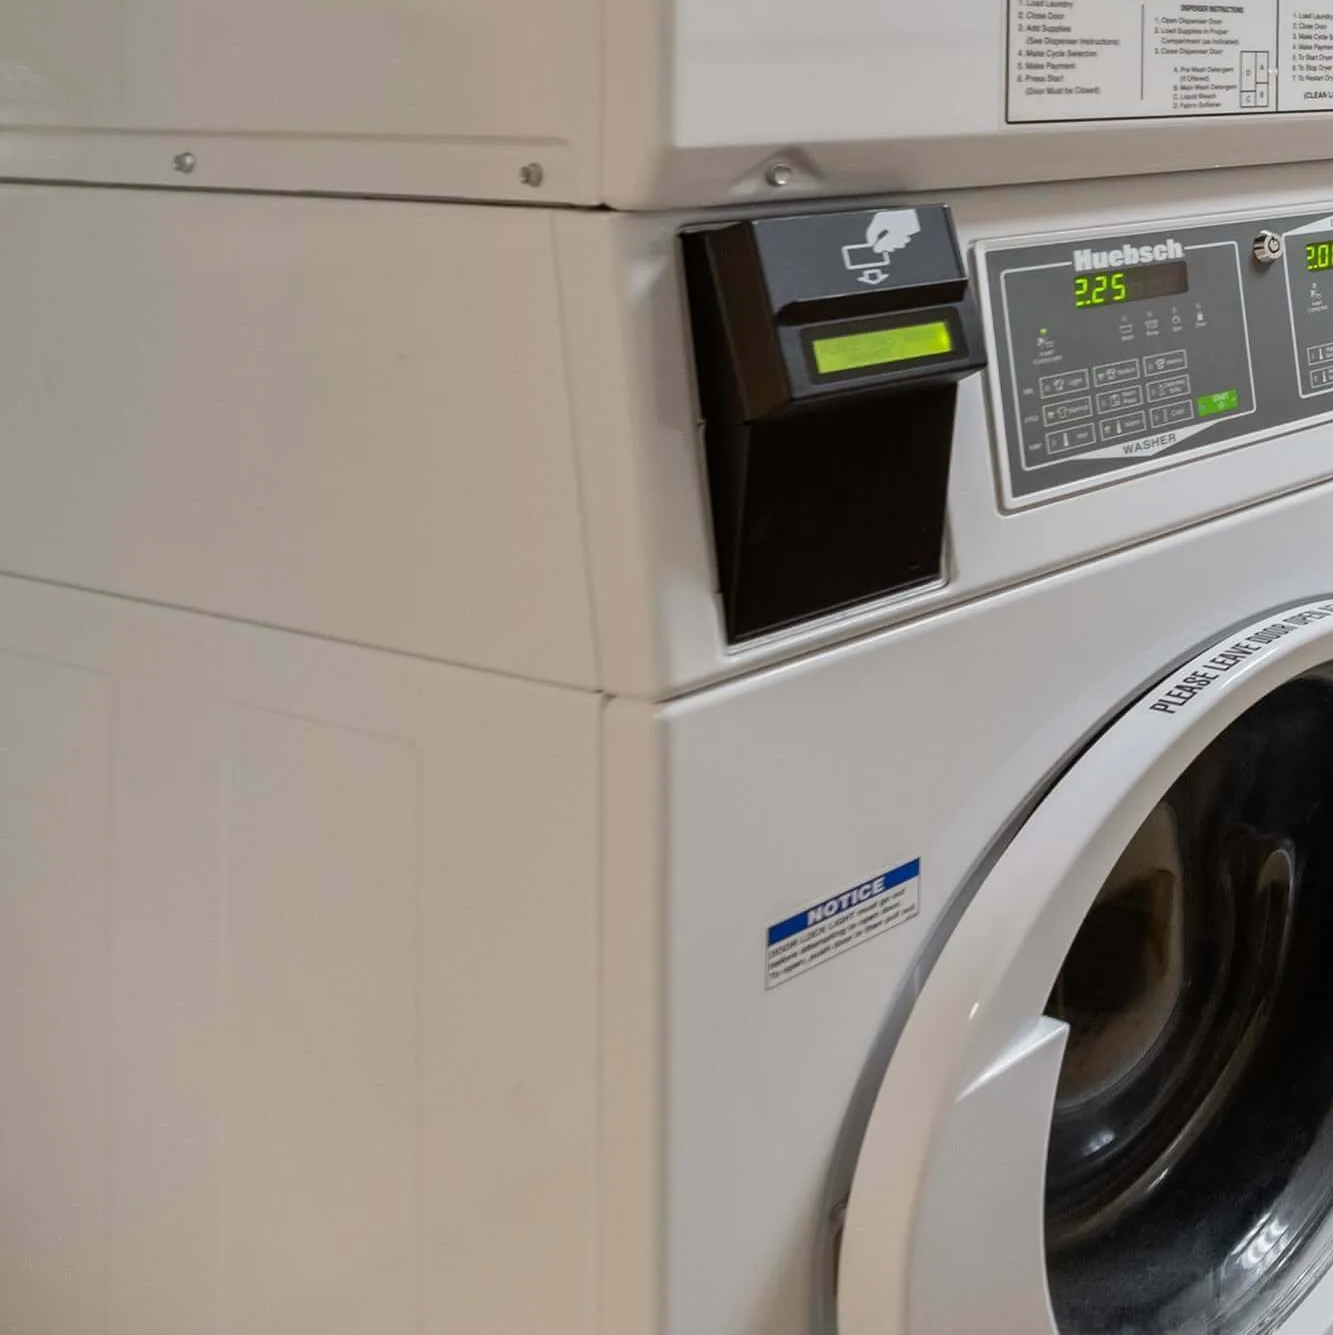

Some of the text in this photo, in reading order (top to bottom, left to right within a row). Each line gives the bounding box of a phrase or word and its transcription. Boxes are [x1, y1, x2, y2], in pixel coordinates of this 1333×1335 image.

[1304, 90, 1327, 99] (CLEAN
[1073, 239, 1185, 271] Huebsch
[1074, 273, 1126, 307] 2.25
[1122, 433, 1177, 454] WASHER
[1148, 670, 1220, 715] PLEASE
[1203, 642, 1262, 672] LEAVE
[1246, 619, 1299, 645] DOOR
[1285, 610, 1329, 626] OPEN
[806, 877, 886, 925] NOTICE
